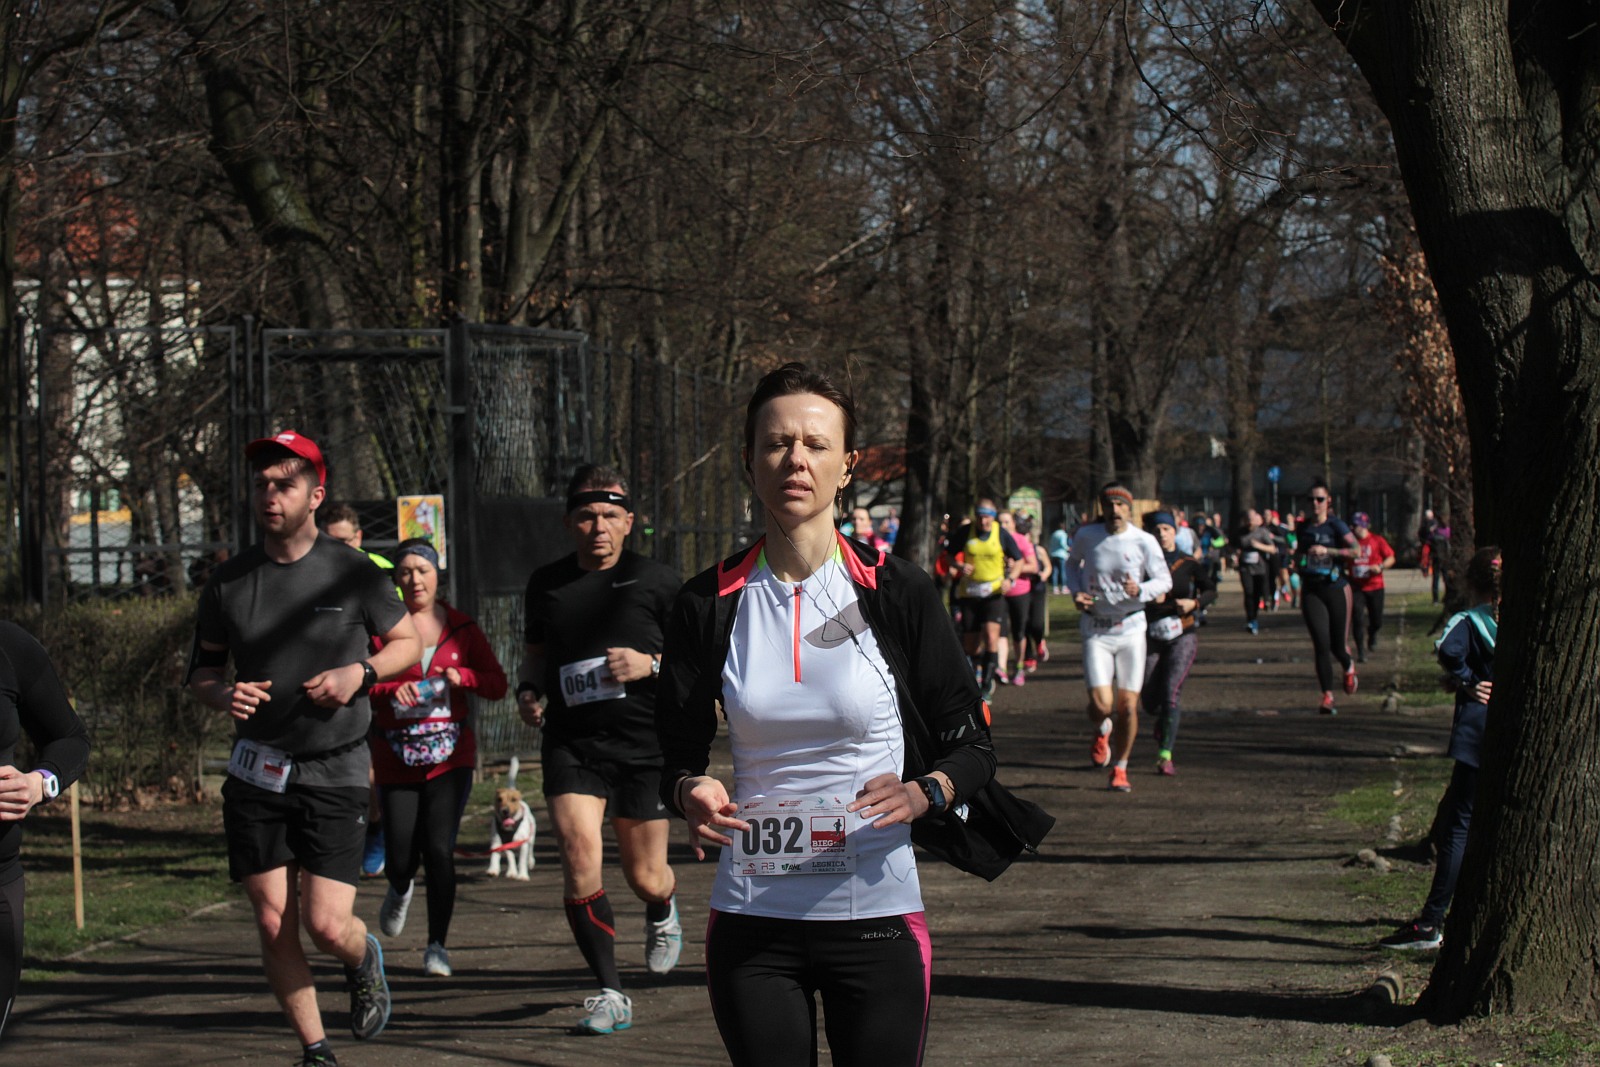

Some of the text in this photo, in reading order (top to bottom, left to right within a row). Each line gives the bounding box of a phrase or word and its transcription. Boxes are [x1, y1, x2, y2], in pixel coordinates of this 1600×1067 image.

[565, 670, 597, 695] 064
[237, 746, 258, 771] 117
[742, 817, 804, 855] 032
[812, 839, 834, 847] BIEG
[811, 860, 846, 868] LEGNICA
